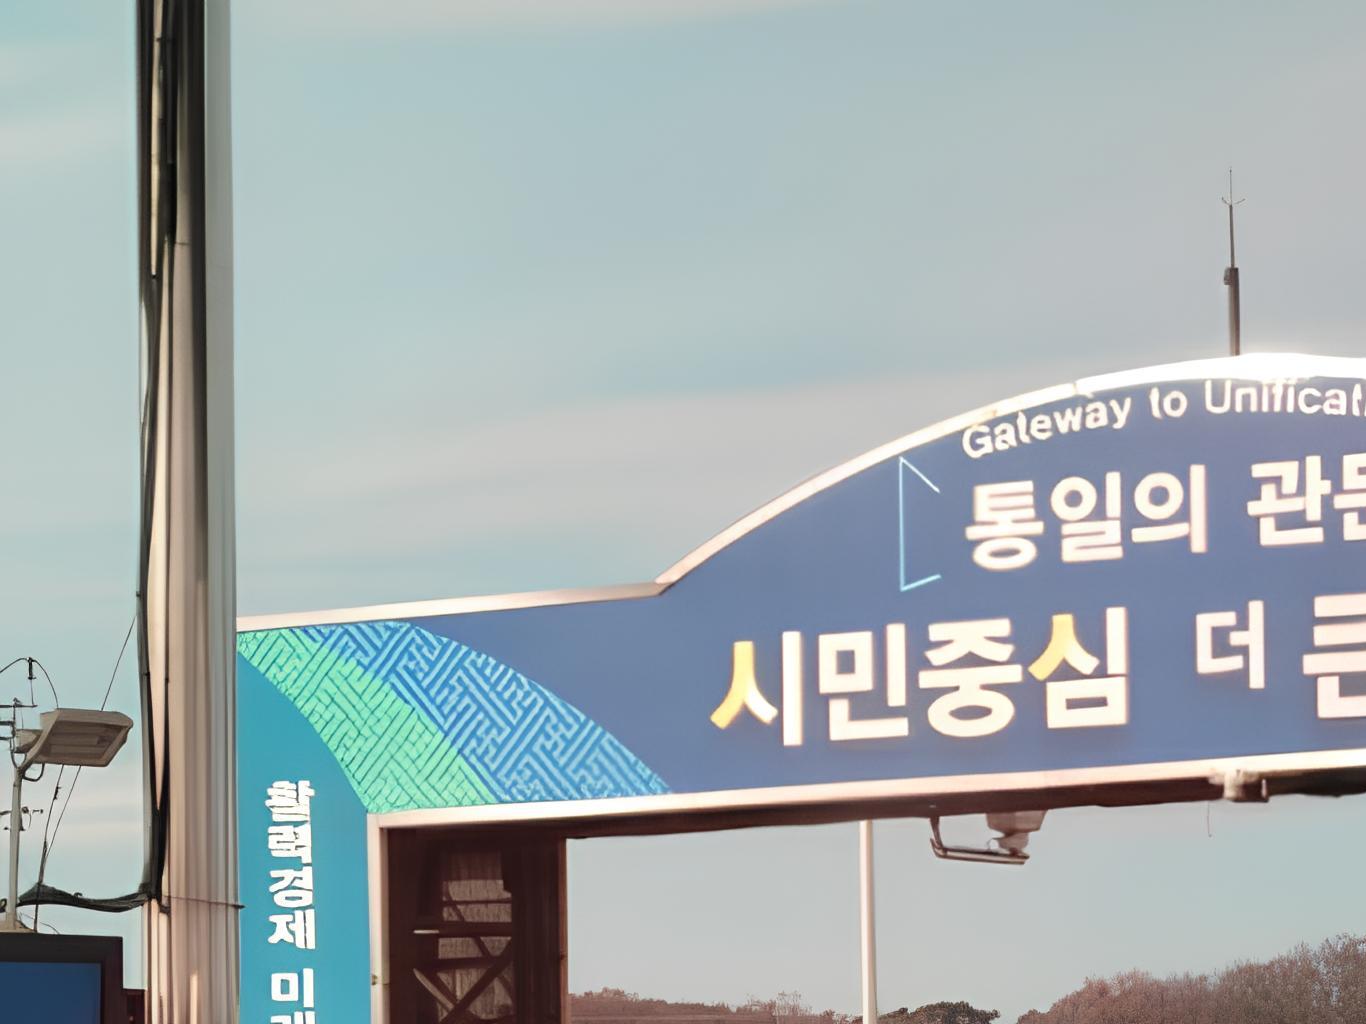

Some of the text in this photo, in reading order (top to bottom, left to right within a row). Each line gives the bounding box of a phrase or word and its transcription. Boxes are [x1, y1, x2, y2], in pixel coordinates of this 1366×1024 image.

[961, 396, 1132, 459] Gateway
[1149, 387, 1189, 419] to
[964, 463, 1208, 571] 통일의
[709, 605, 1130, 746] 시민중심
[1195, 600, 1266, 690] 더
[264, 780, 316, 950] 활력경제
